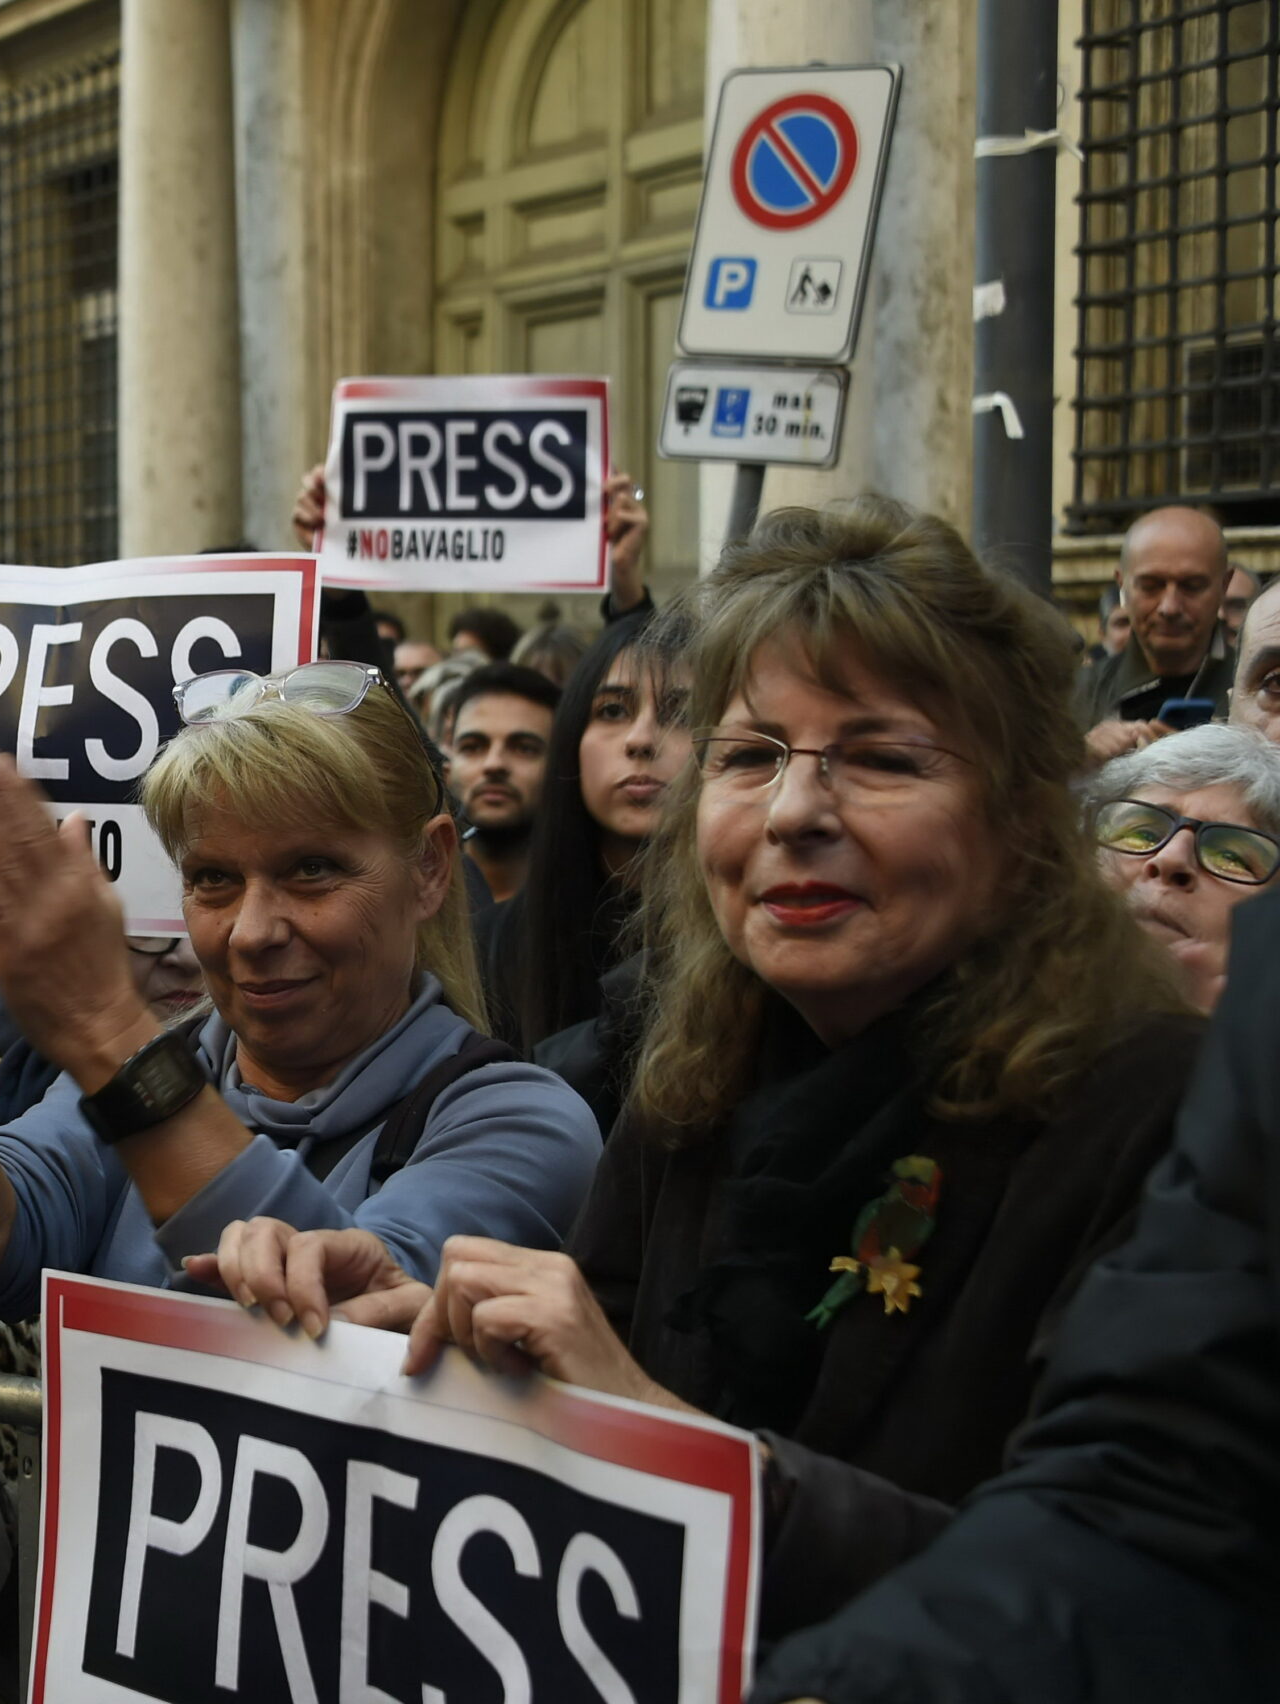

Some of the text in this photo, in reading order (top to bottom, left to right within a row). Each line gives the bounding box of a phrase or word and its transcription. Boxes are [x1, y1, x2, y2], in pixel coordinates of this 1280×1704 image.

[714, 261, 748, 306] P
[352, 420, 574, 511] PRESS
[347, 529, 506, 562] #NOBAVAGLIO
[115, 1410, 642, 1704] PRESS
